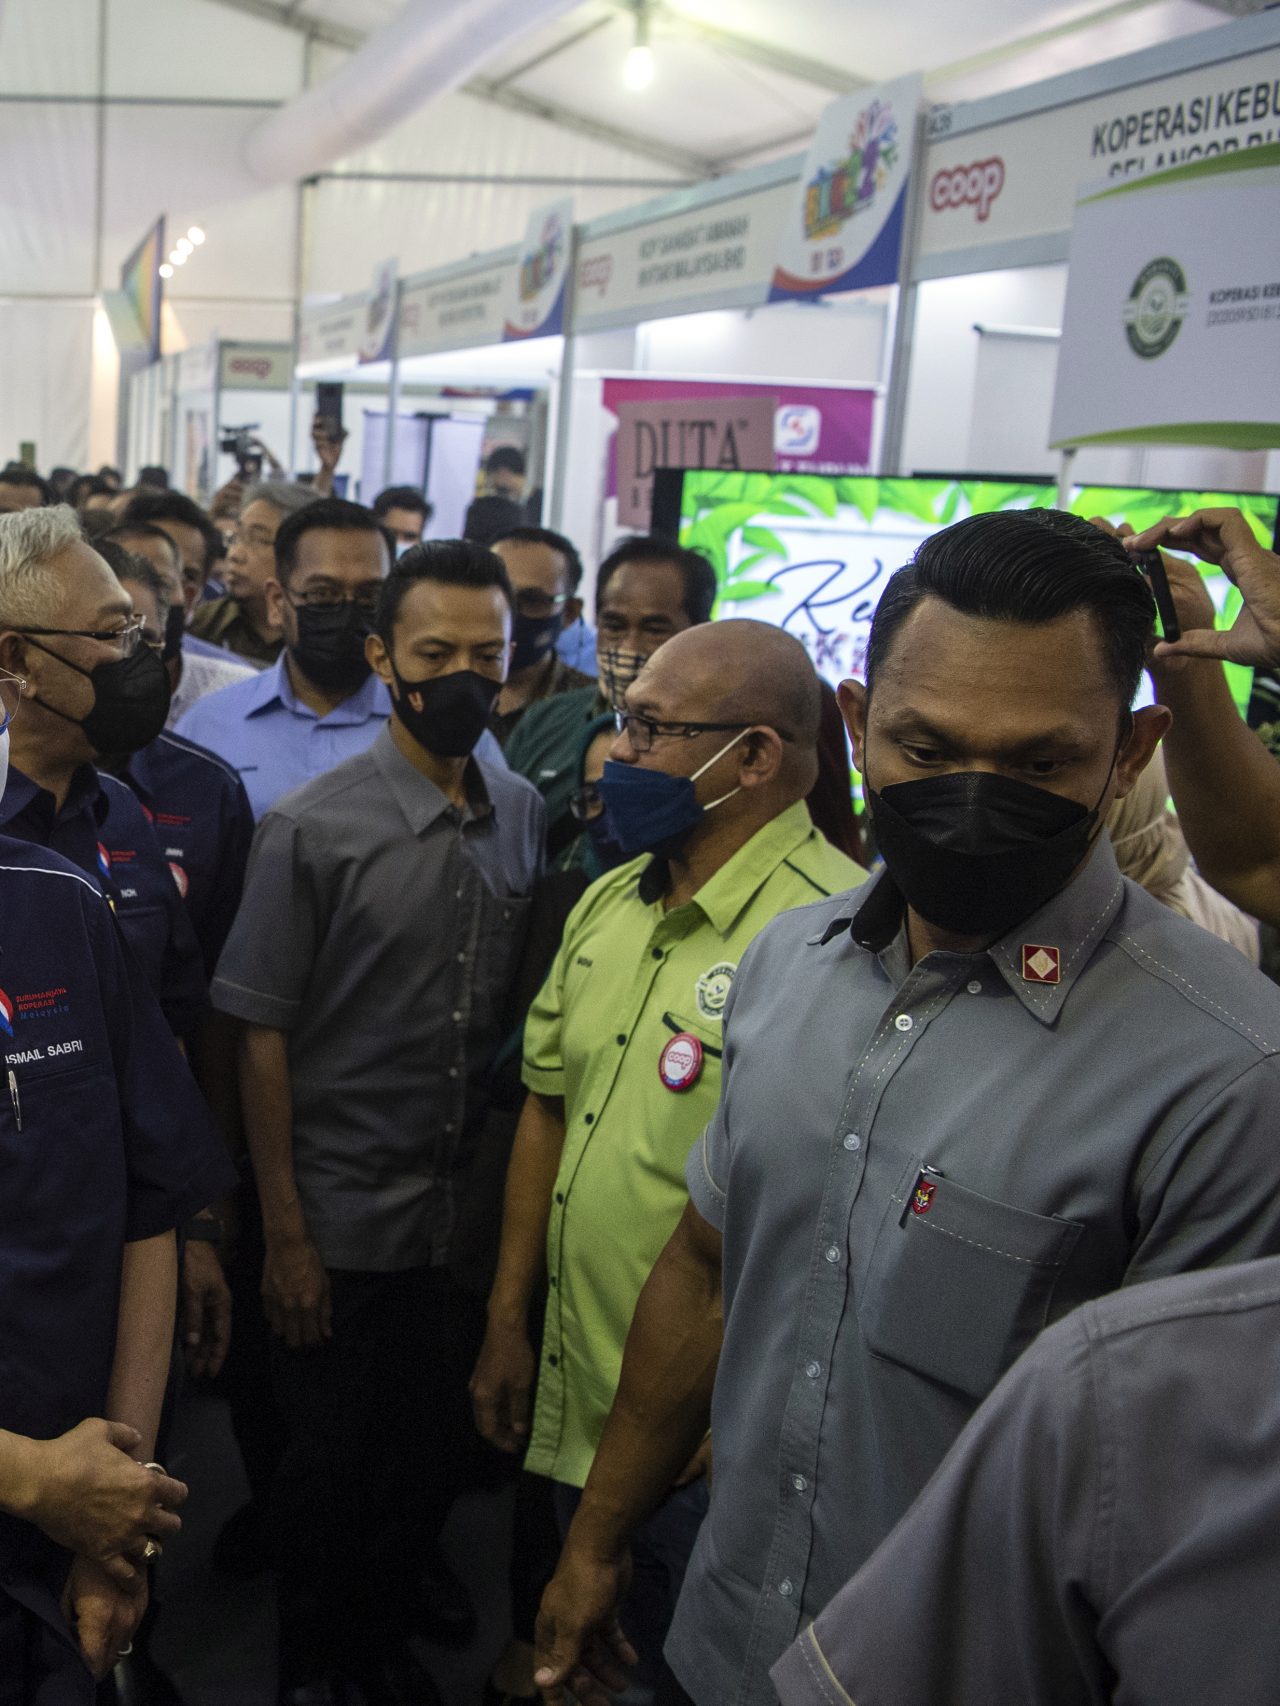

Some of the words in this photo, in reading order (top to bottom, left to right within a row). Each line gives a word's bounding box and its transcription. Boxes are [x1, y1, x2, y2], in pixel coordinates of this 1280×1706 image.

[1091, 96, 1212, 159] KOPERASI
[930, 156, 1005, 222] coop
[4, 1048, 46, 1065] ISMAIL
[47, 1039, 84, 1057] SABRI
